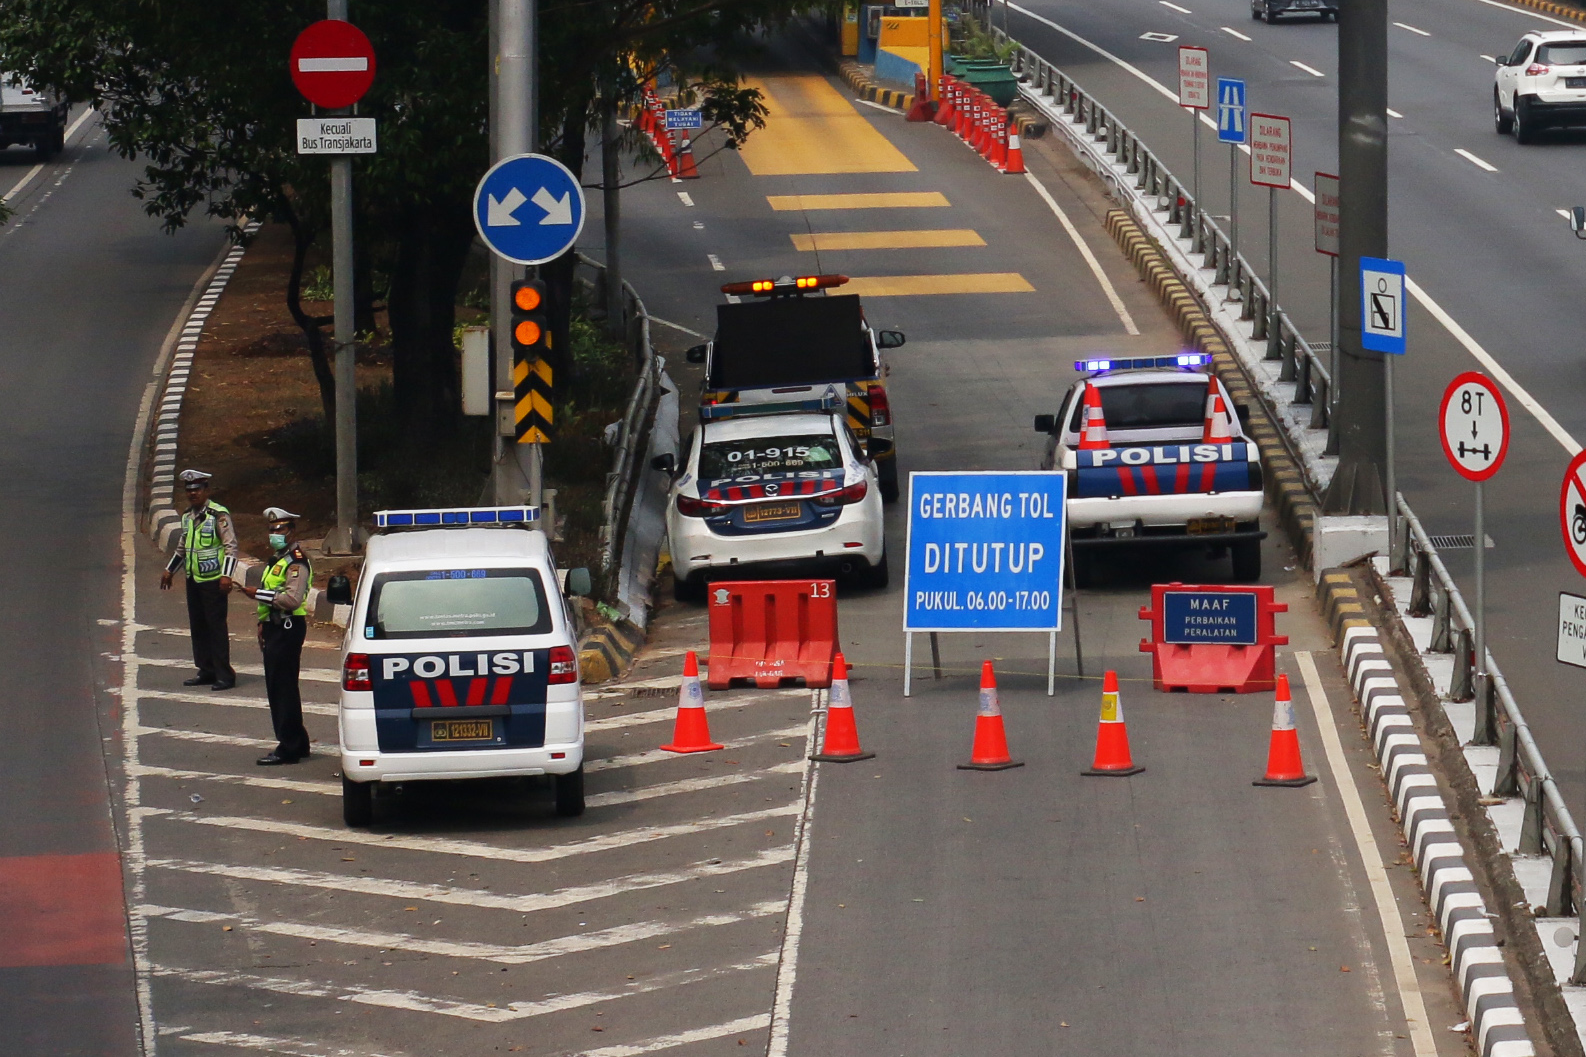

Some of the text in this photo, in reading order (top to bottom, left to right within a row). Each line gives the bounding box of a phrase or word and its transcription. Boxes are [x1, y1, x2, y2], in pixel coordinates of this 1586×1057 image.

[320, 122, 351, 135] Kecuali
[302, 136, 372, 152] Bus Transjakarta
[727, 446, 811, 463] 01-915
[1091, 443, 1233, 467] POLISI
[710, 470, 833, 488] POLISI
[919, 492, 1054, 519] GERBANG TOL
[924, 542, 1044, 574] DITUTUP
[810, 582, 831, 598] 13
[915, 591, 965, 611] PUKUL.
[1190, 598, 1230, 611] MAAF
[1185, 616, 1236, 625] PERBAIKAN
[1184, 628, 1237, 637] PERALATAN
[382, 651, 536, 680] POLISI
